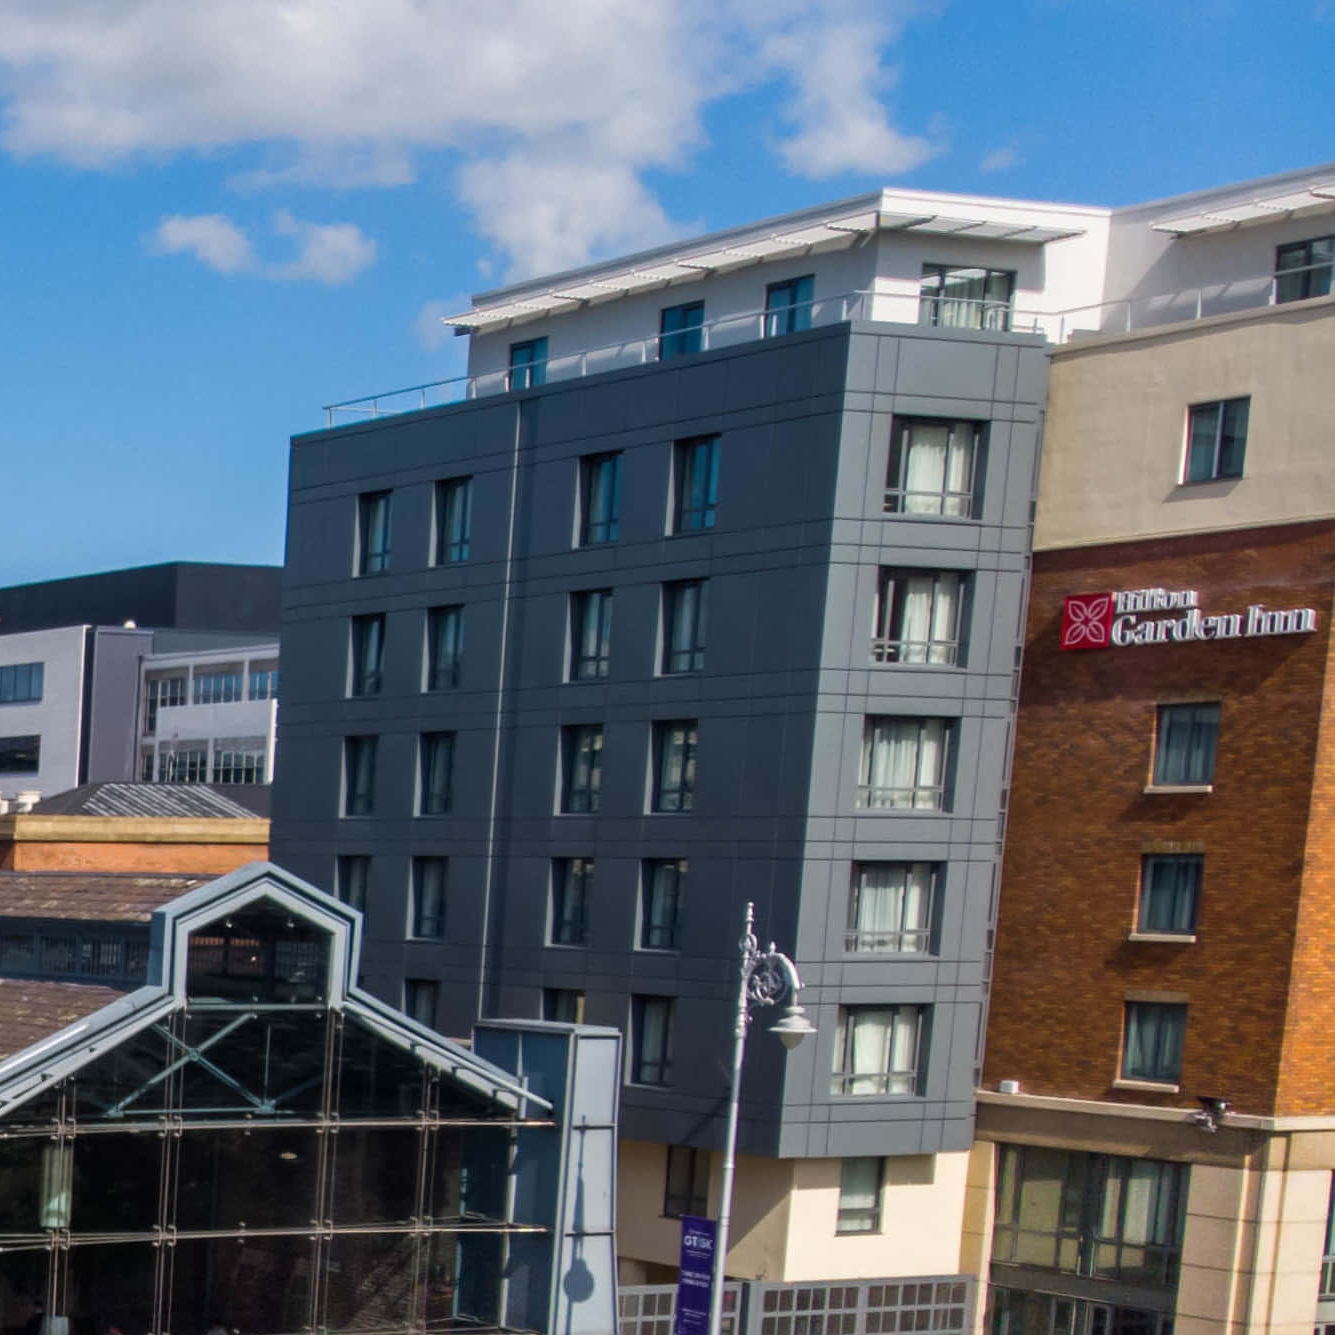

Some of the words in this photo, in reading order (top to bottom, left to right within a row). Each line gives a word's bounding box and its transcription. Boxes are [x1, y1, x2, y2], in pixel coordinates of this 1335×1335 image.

[1113, 588, 1199, 614] Hilton
[1111, 608, 1243, 647] Garden
[1246, 604, 1318, 636] Inn
